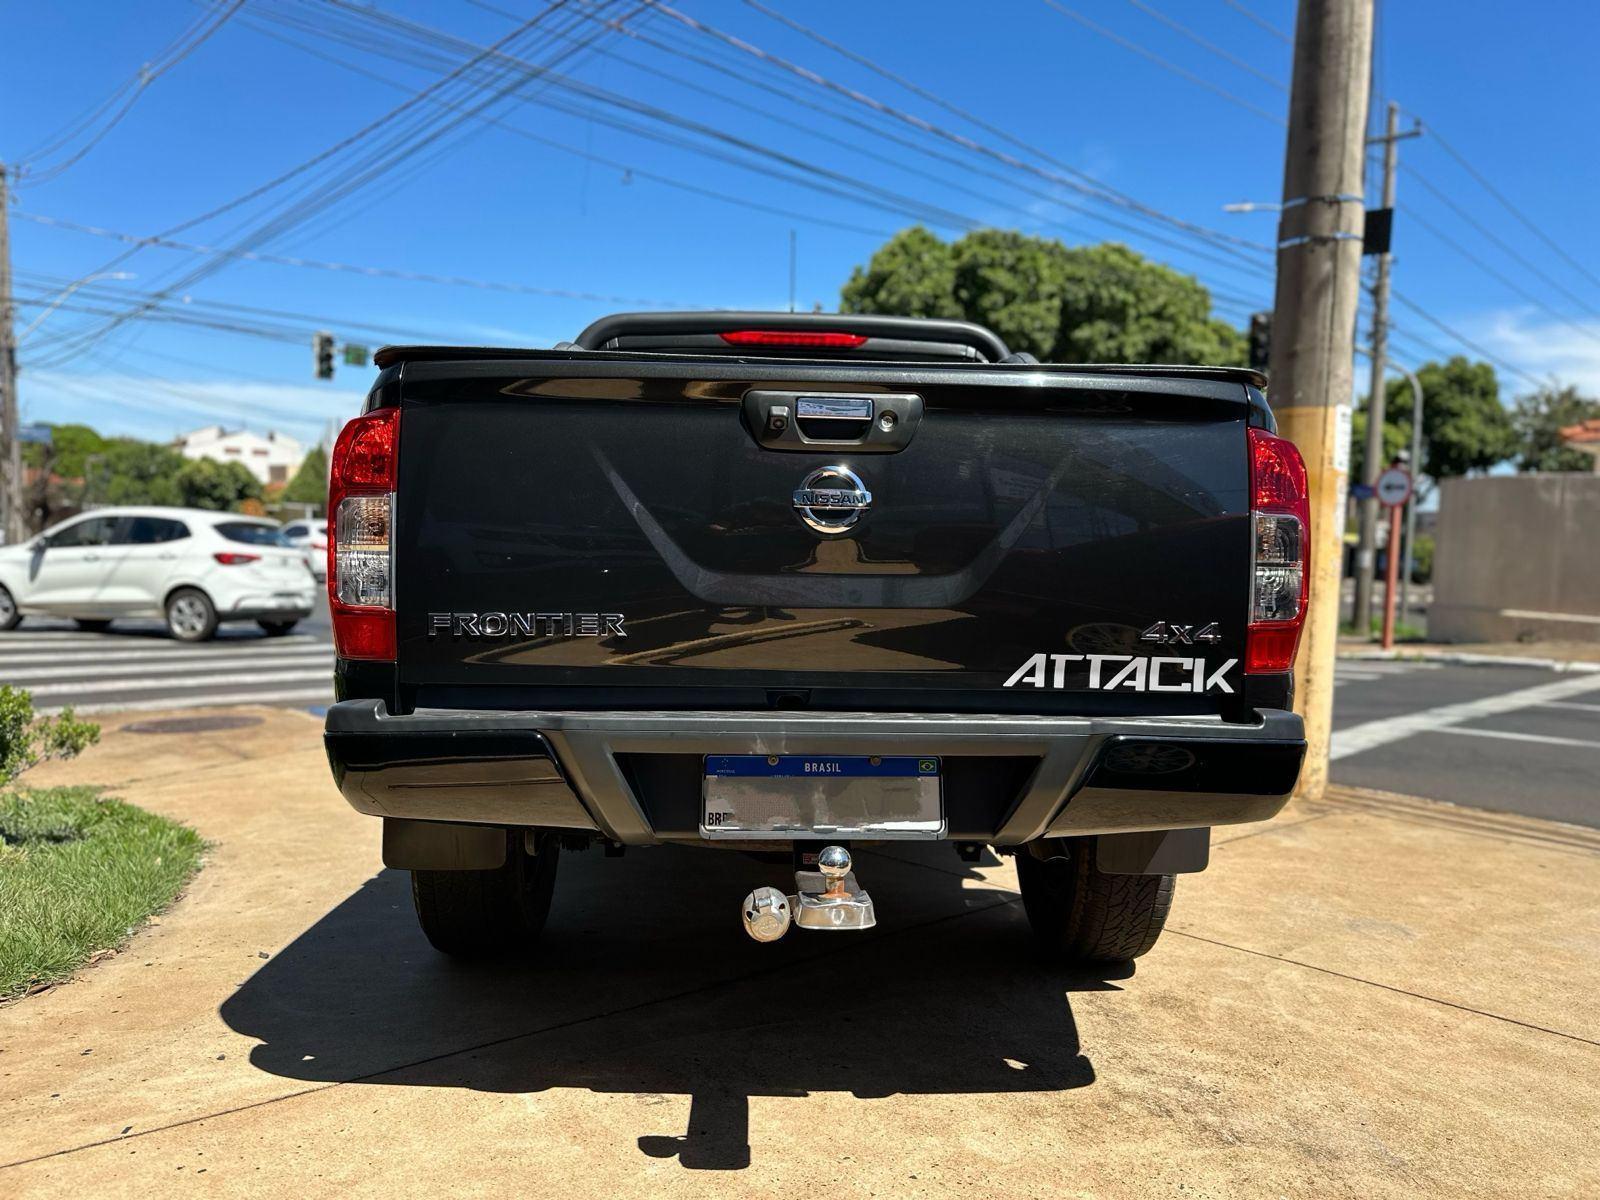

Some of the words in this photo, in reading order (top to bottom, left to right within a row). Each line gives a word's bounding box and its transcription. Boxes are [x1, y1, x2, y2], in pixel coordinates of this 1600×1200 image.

[801, 492, 867, 504] NISSAN
[427, 612, 628, 637] FRONTIER
[1140, 620, 1222, 645] 4x4
[1002, 653, 1239, 694] ATTACK
[804, 762, 842, 773] BRASIL
